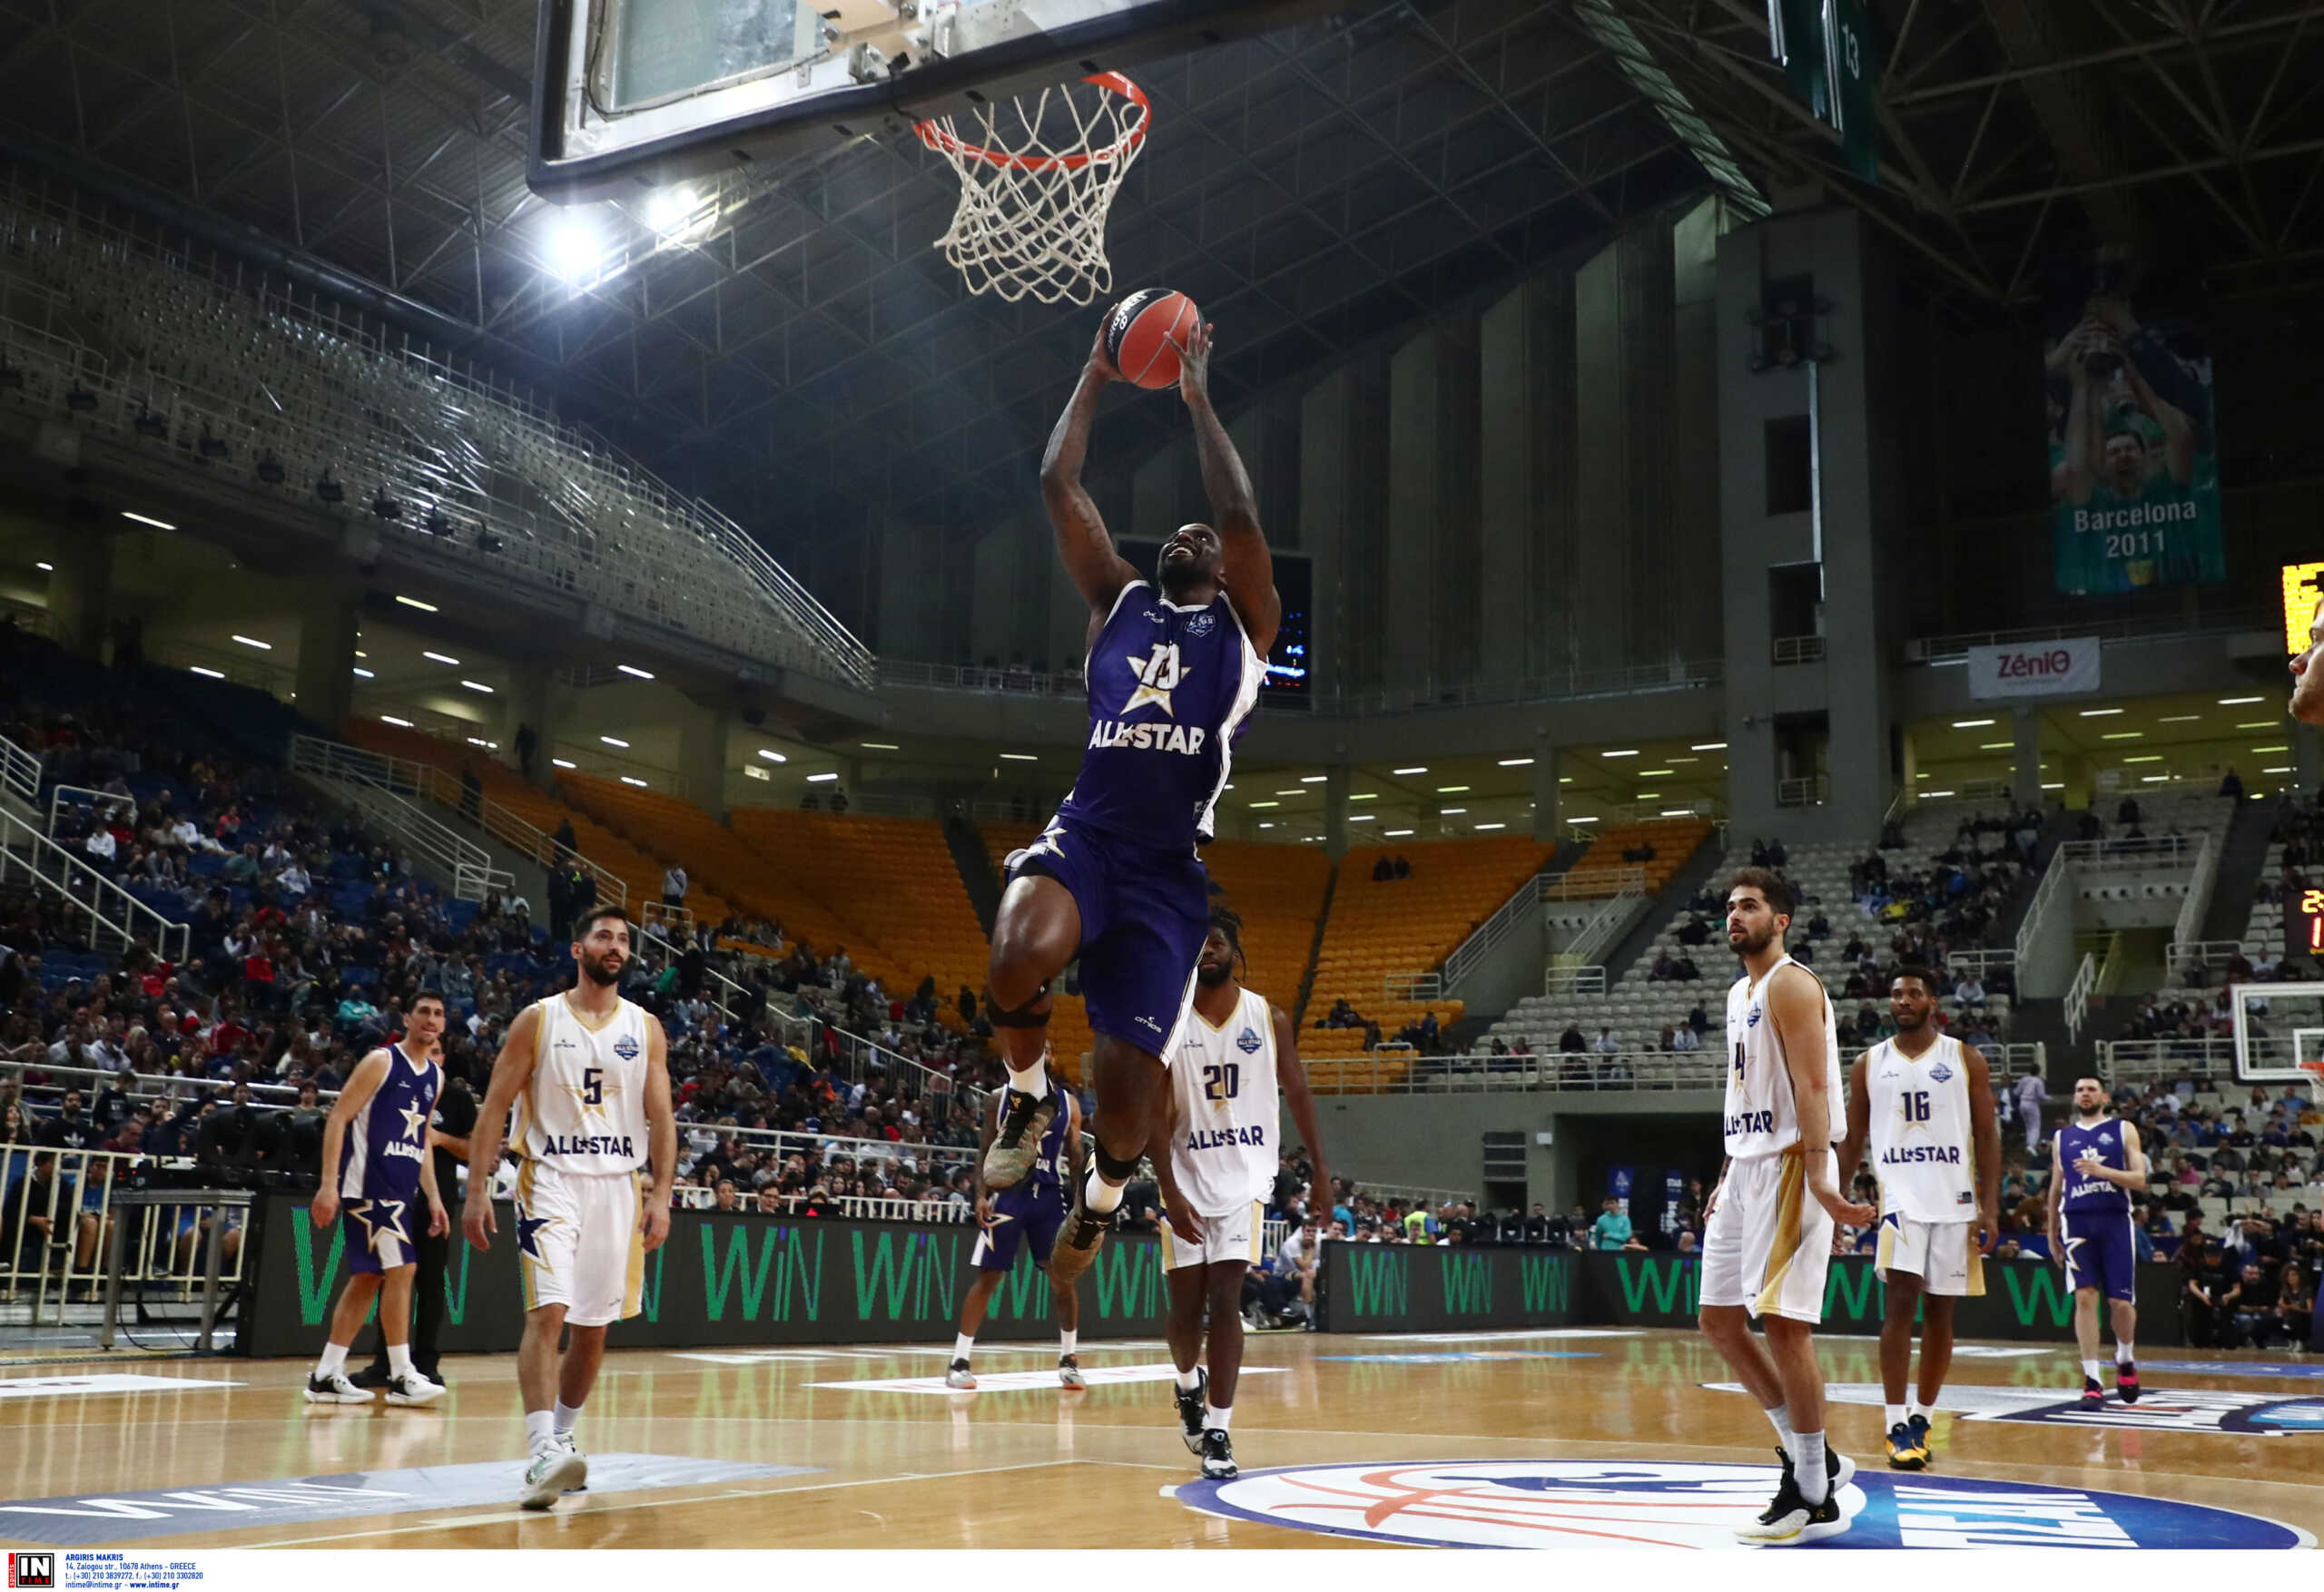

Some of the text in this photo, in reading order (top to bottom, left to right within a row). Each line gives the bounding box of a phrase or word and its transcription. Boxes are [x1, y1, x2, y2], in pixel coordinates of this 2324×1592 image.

[2074, 501, 2197, 533] Barcelona
[2106, 530, 2165, 558] 2011
[1133, 723, 1206, 755] STAR
[584, 1067, 604, 1106] 5
[1203, 1063, 1239, 1101] 20
[1901, 1091, 1931, 1123] 16
[543, 1135, 635, 1158] ALL STAR
[1187, 1130, 1224, 1152] ALL
[1914, 1146, 1961, 1165] STAR
